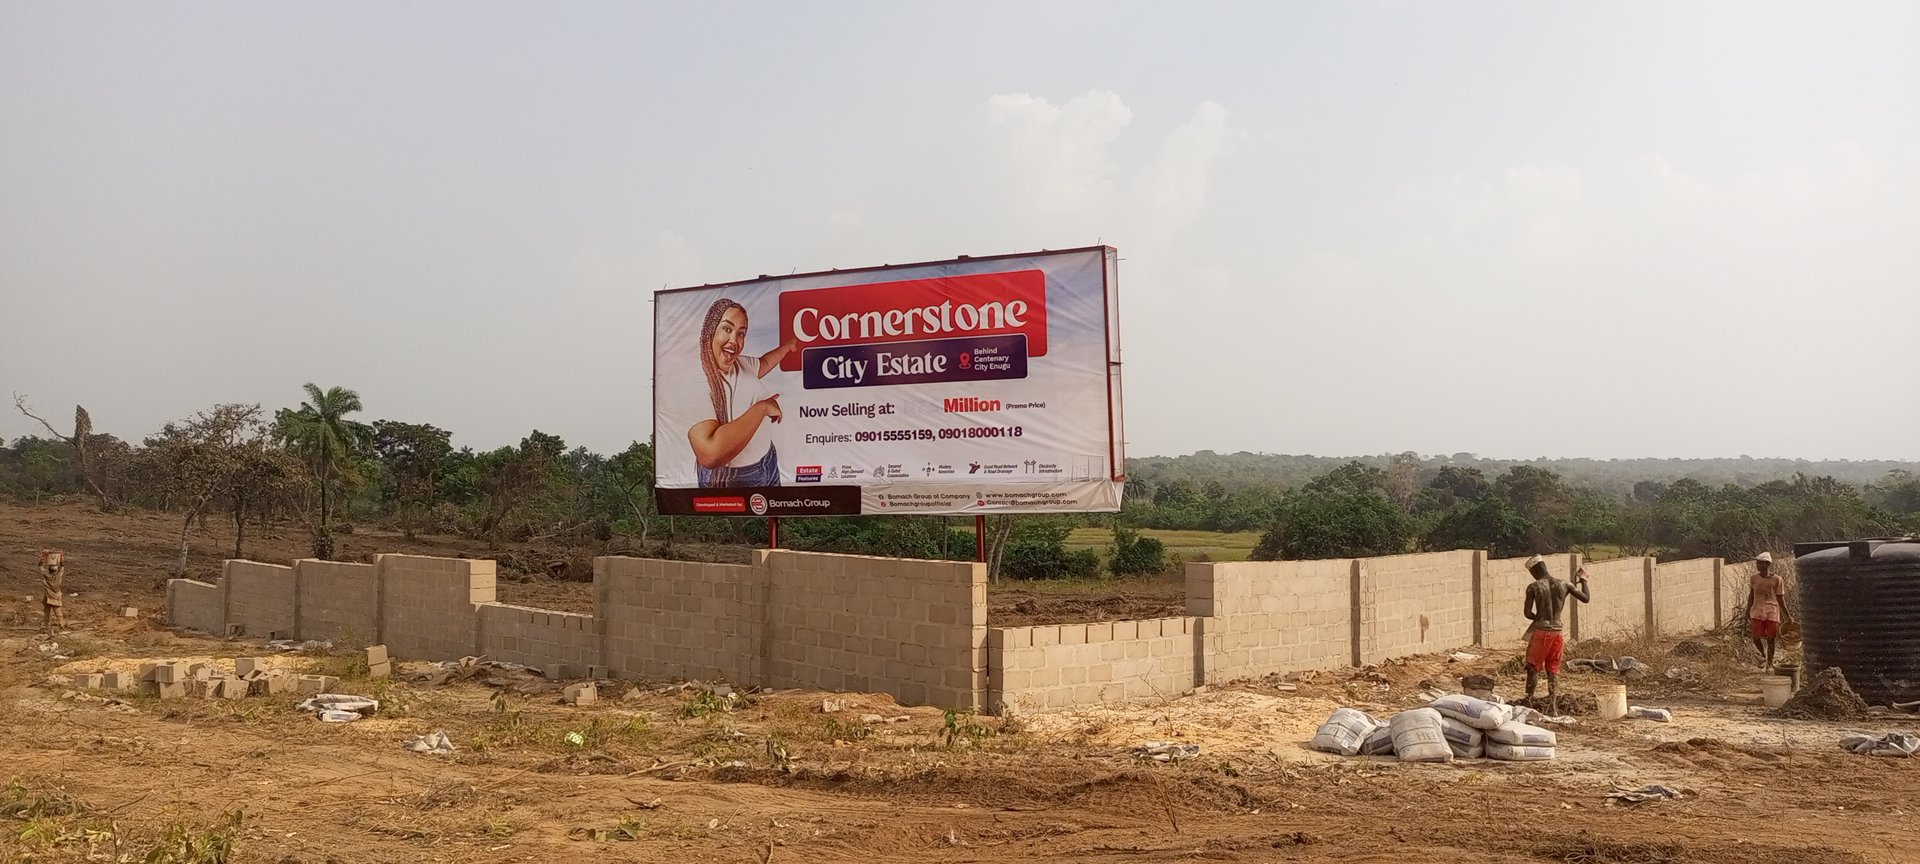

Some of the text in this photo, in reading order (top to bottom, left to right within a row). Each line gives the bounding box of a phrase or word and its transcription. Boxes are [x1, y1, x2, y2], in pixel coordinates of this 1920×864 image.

[793, 300, 1028, 342] Cornerstone
[974, 347, 998, 355] Behind
[822, 353, 947, 384] City Estate
[800, 403, 895, 418] Now Selling at:
[944, 397, 1000, 412] Million
[806, 426, 1022, 445] Enquires: 09015555159, 09018000118
[804, 499, 831, 508] Group
